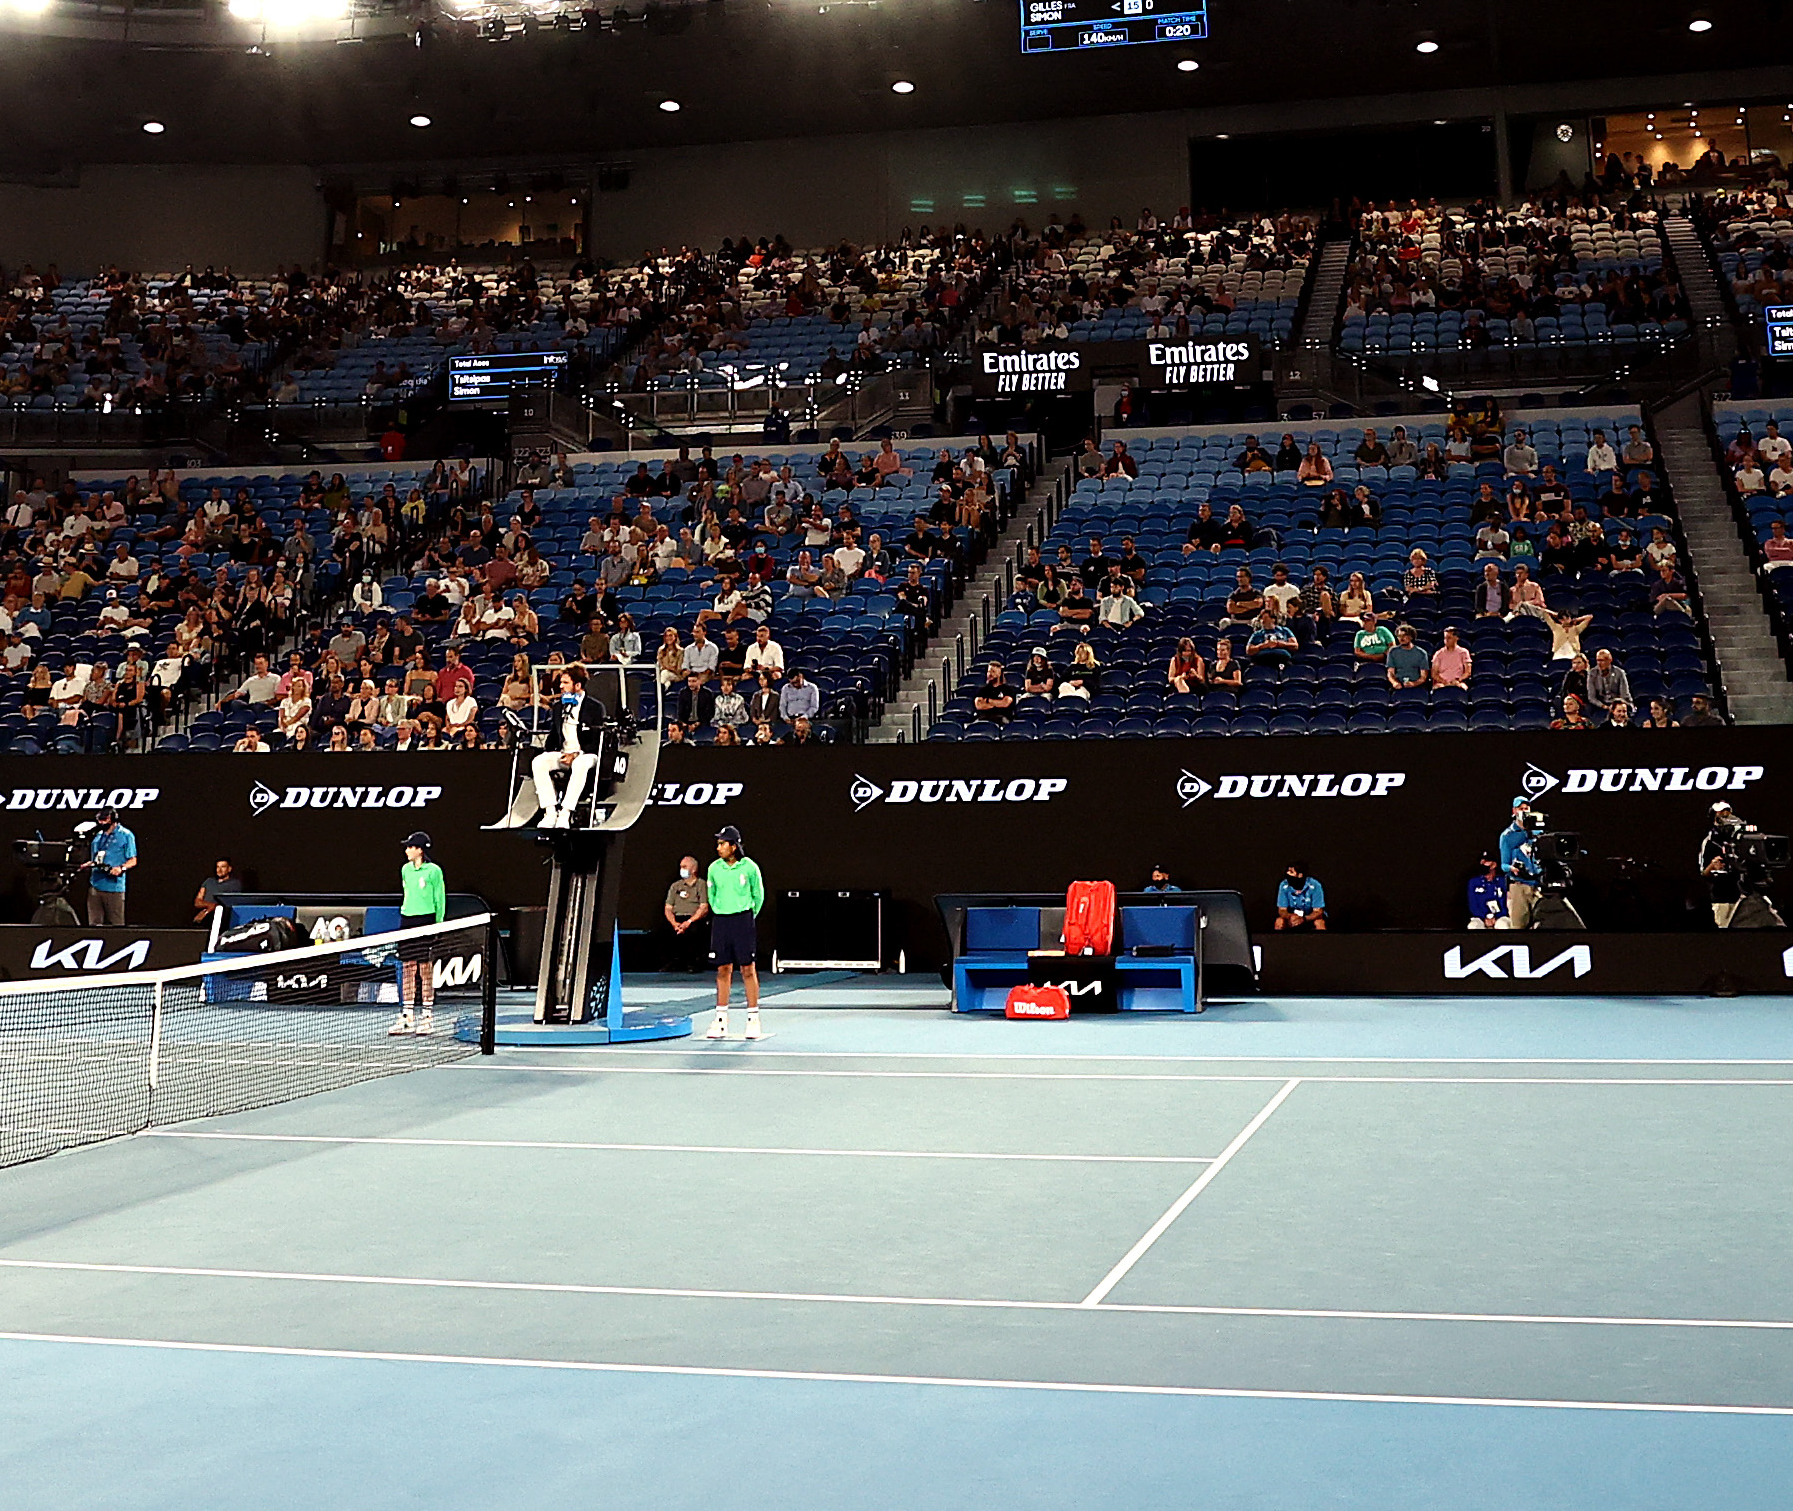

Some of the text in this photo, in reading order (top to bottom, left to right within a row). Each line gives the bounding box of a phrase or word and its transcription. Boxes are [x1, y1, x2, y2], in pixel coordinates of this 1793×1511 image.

[1030, 0, 1063, 12] GILLES
[1127, 1, 1139, 10] 15
[1030, 11, 1062, 23] SIMON
[1165, 24, 1191, 37] 0:20
[1770, 309, 1793, 318] Total
[982, 349, 1080, 374] Emirates
[1148, 340, 1249, 366] Emirates
[997, 371, 1066, 393] FLY BETTER
[1165, 363, 1235, 385] FLY BETTER
[454, 386, 480, 396] Simon
[1212, 772, 1405, 798] DUNLOP
[1561, 766, 1764, 792] DUNLOP
[6, 788, 159, 810] DUNLOP
[278, 786, 442, 809] DUNLOP
[885, 778, 1068, 803] DUNLOP
[31, 939, 151, 970] KIA
[1443, 945, 1591, 978] KIA
